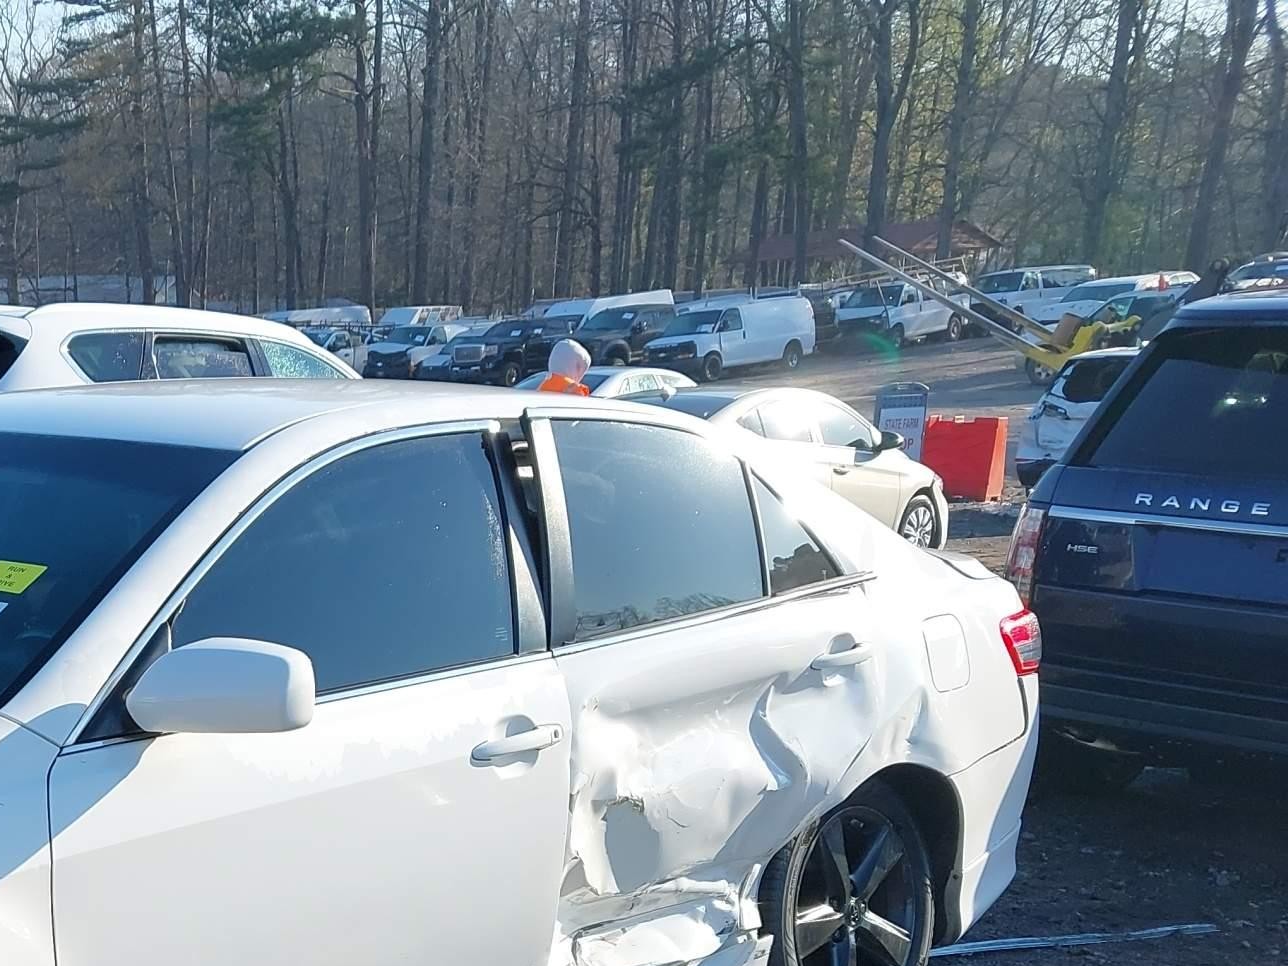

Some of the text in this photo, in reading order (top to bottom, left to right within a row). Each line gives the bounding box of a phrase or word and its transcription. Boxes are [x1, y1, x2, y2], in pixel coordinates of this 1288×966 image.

[1134, 492, 1272, 516] RANGE
[1066, 543, 1099, 554] HSE
[7, 565, 27, 573] RUN
